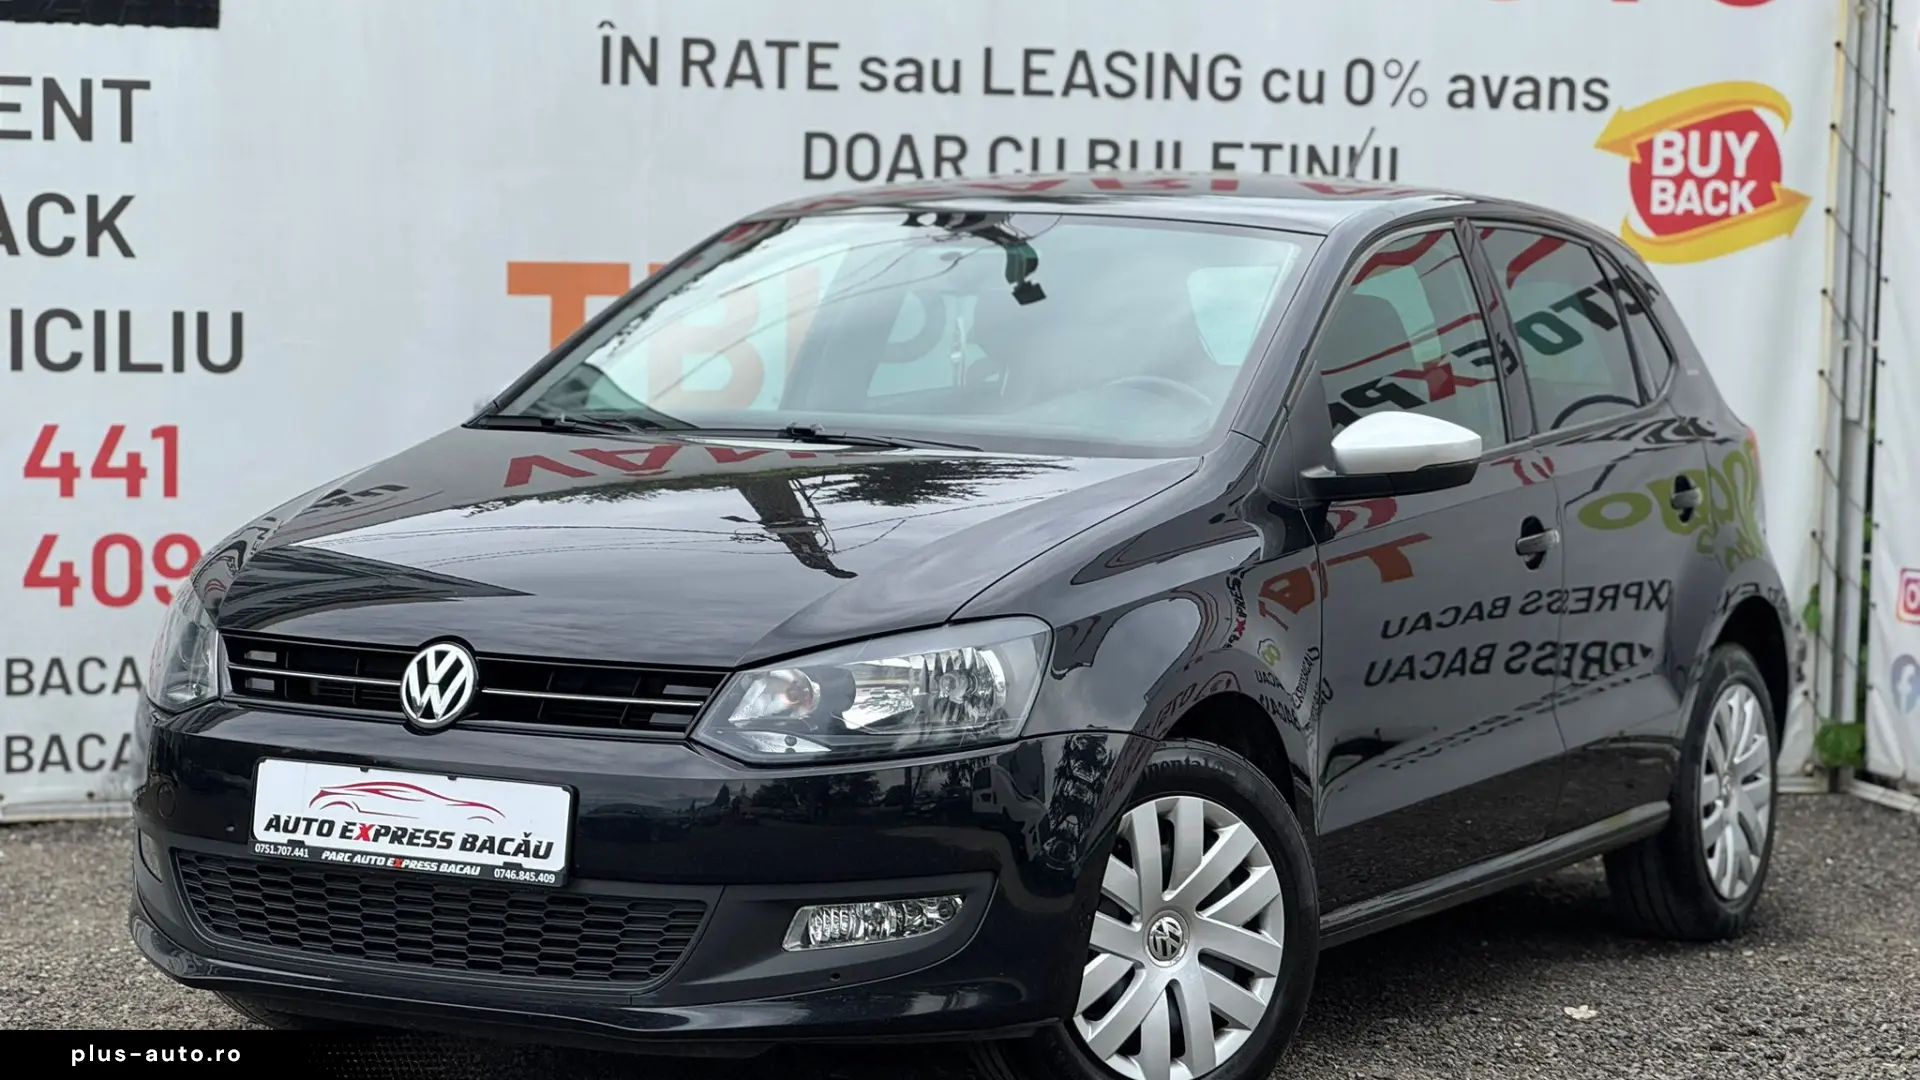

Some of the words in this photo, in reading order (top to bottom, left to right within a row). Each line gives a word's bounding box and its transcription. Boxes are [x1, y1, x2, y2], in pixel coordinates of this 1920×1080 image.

[598, 20, 659, 87] ÎN
[681, 37, 840, 91] RATE
[859, 55, 961, 95] sau
[983, 46, 1242, 102] LEASING
[1262, 68, 1325, 105] cu
[1344, 57, 1428, 108] 0%
[1447, 73, 1610, 113] avans
[803, 131, 968, 182] DOAR
[988, 135, 1065, 173] CU
[1651, 130, 1760, 178] BUY
[1650, 178, 1757, 216] BACK
[10, 308, 244, 374] ICILIU
[23, 424, 180, 498] 441
[23, 533, 202, 607] 409
[254, 843, 310, 859] 0751.707.441
[263, 814, 336, 838] AUTO
[338, 820, 456, 850] EXPRESS
[458, 832, 555, 860] BACĂU
[321, 850, 353, 862] PARC
[352, 854, 386, 866] AUTO
[386, 857, 438, 872] EXPRESS
[439, 863, 482, 876] BACAU
[493, 868, 556, 884] 0746.845.409
